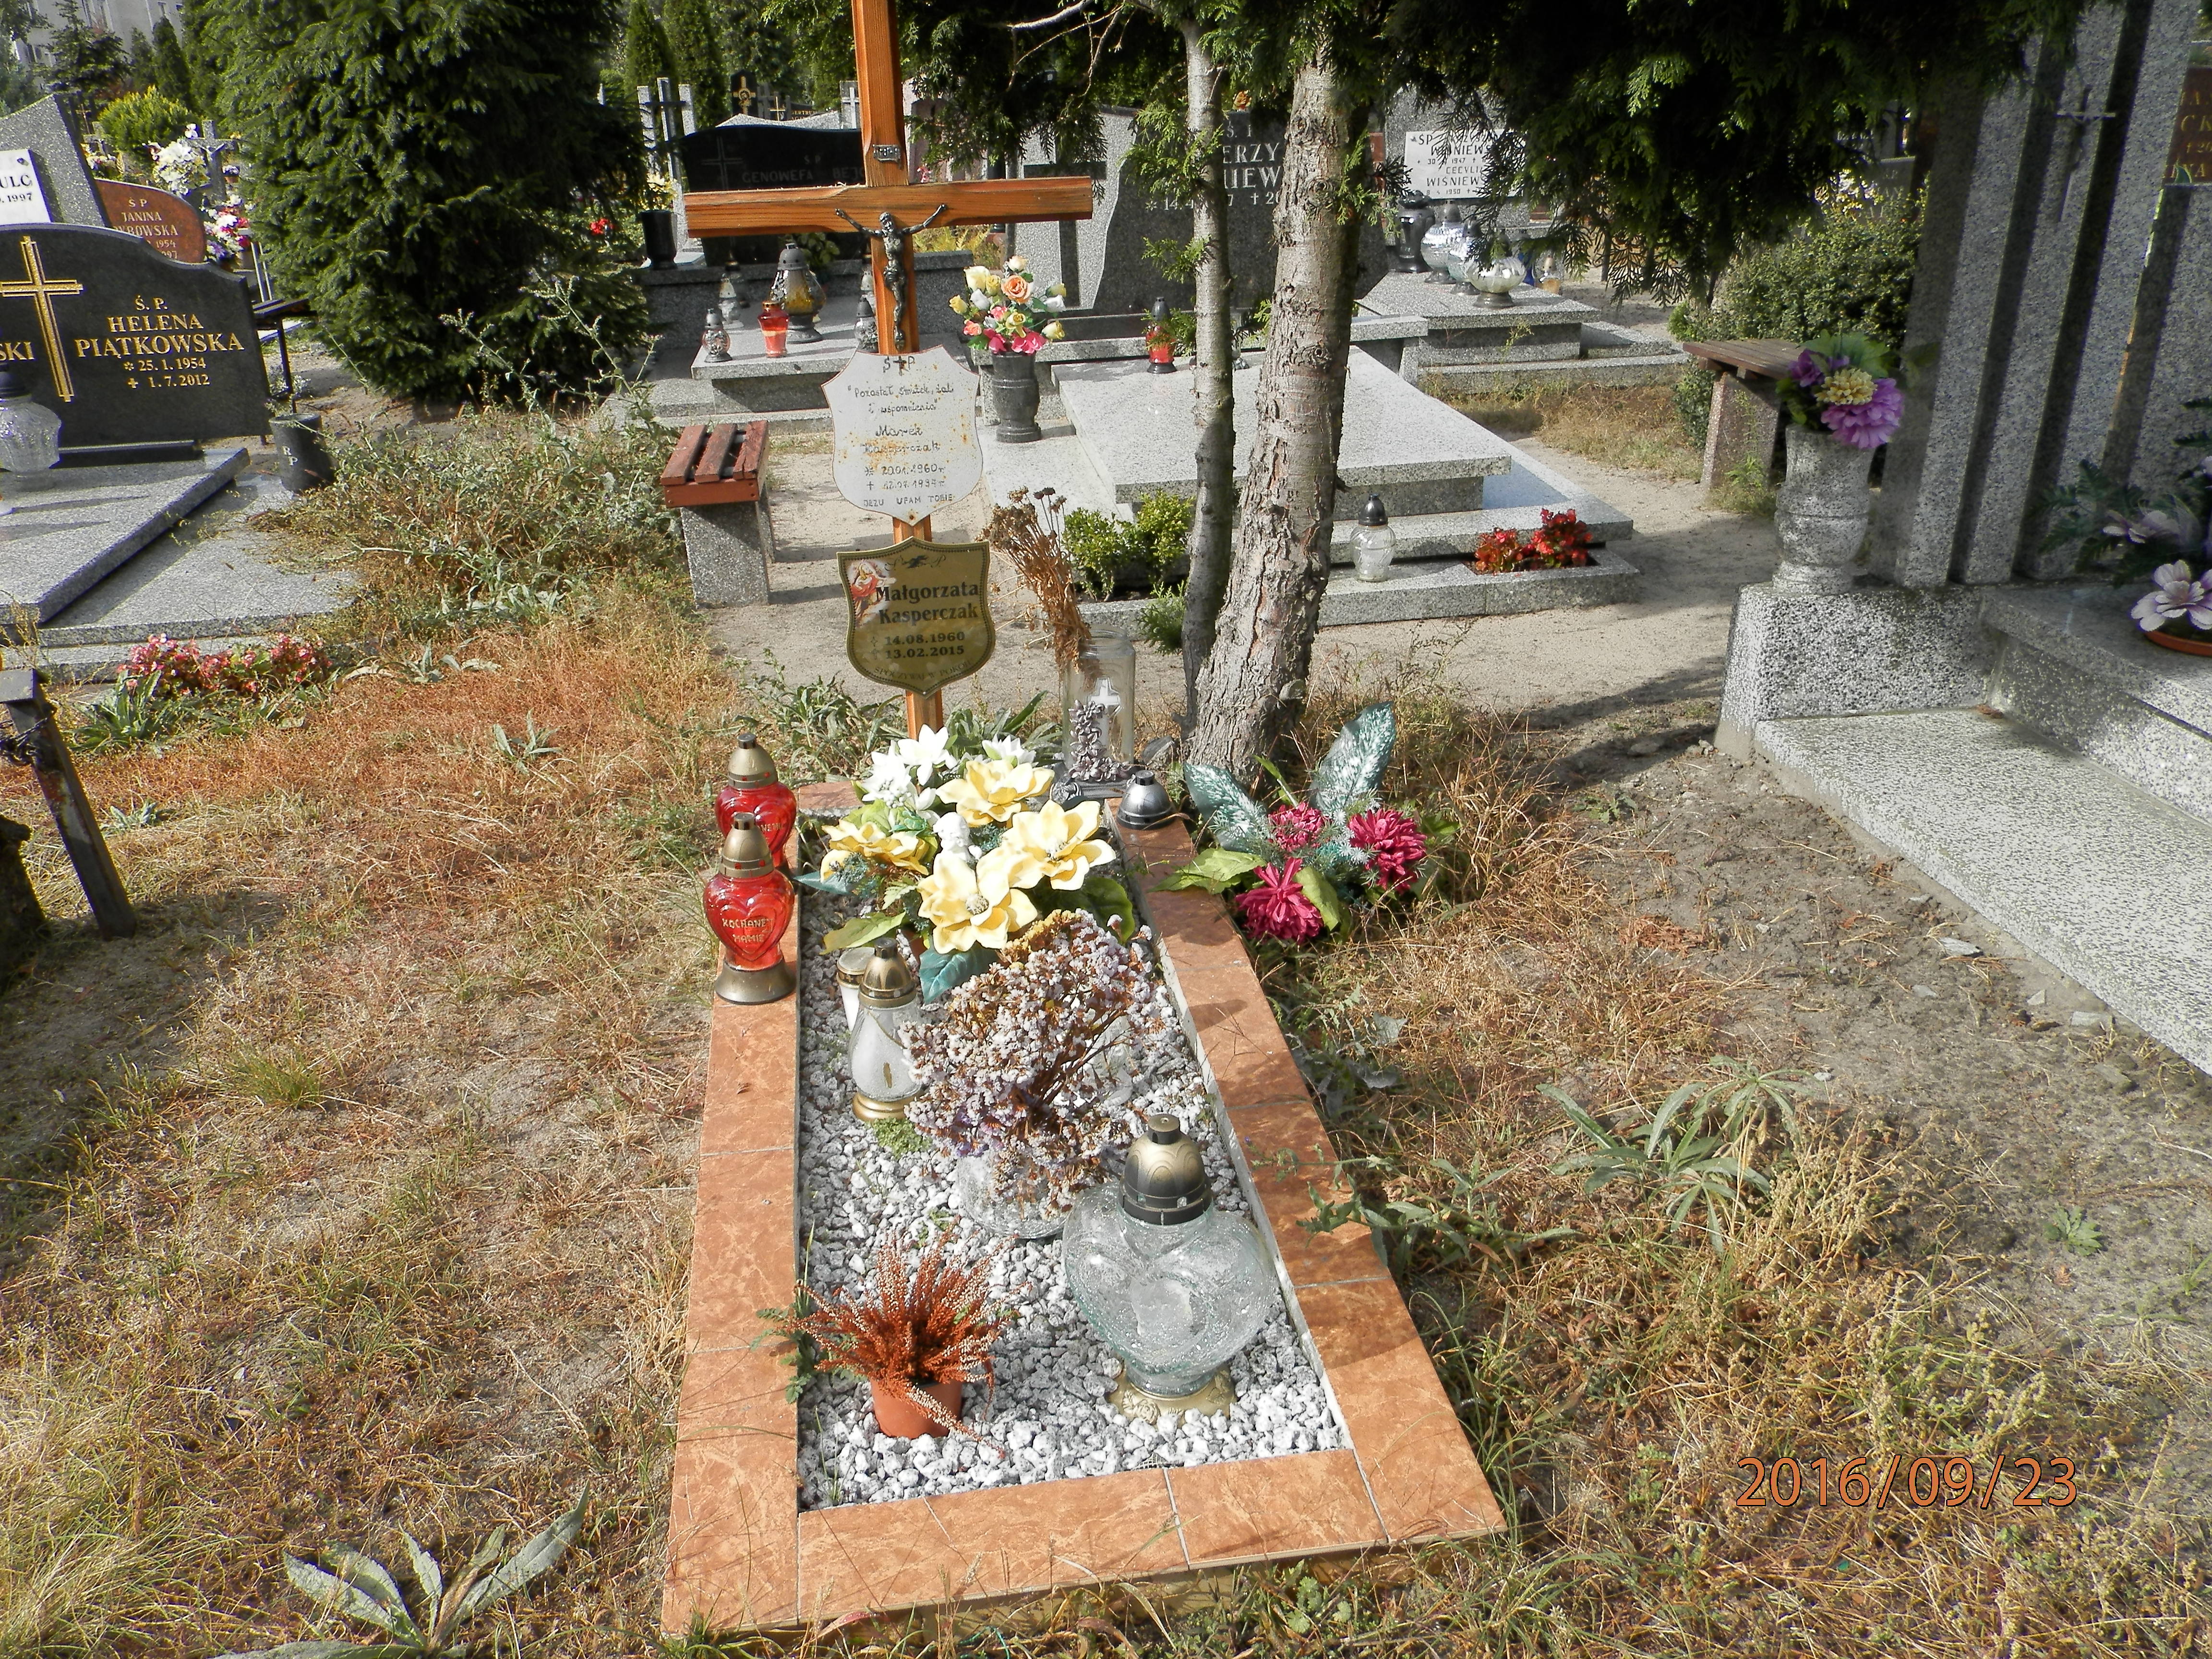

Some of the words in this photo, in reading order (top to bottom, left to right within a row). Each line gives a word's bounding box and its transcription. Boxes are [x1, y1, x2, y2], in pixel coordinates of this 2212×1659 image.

[1223, 143, 1280, 164] ERZY
[742, 170, 814, 183] GENOWEFA
[121, 212, 162, 222] JANINA
[107, 313, 204, 333] HELENA
[74, 332, 245, 359] PIĄTKOWSKA
[875, 424, 923, 437] Marek
[282, 445, 292, 456] R
[288, 456, 298, 466] P
[896, 496, 921, 505] UFAM
[927, 493, 953, 503] TOBIE
[876, 581, 979, 604] Małgorzata
[879, 603, 978, 626] Kasperczak
[884, 632, 965, 646] 14.08.1960
[885, 645, 965, 659] 13.02.2015
